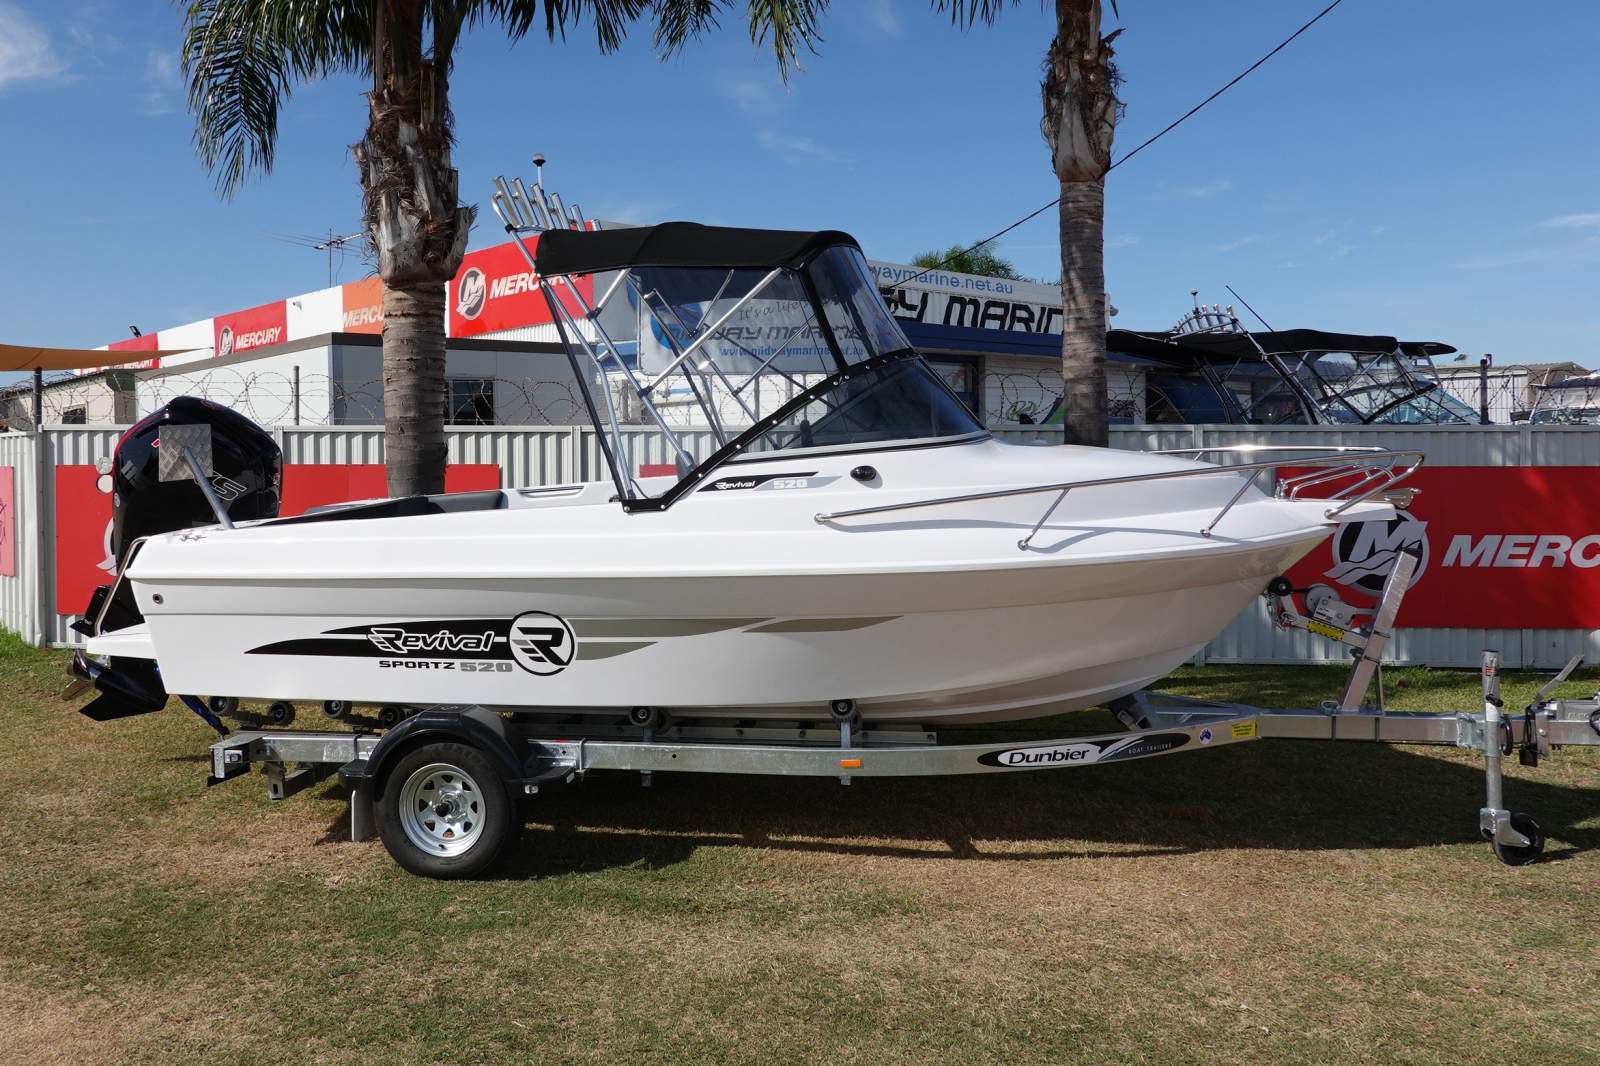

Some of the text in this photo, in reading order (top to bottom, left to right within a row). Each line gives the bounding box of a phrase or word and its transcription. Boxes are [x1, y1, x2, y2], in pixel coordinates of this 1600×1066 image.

[489, 271, 583, 300] MERC
[235, 326, 282, 350] MERCURY
[767, 325, 864, 339] MARNE
[714, 479, 807, 490] Revival 520
[367, 627, 494, 653] Revival
[378, 660, 513, 673] SPORTZ 520
[1008, 748, 1090, 765] Dunbier
